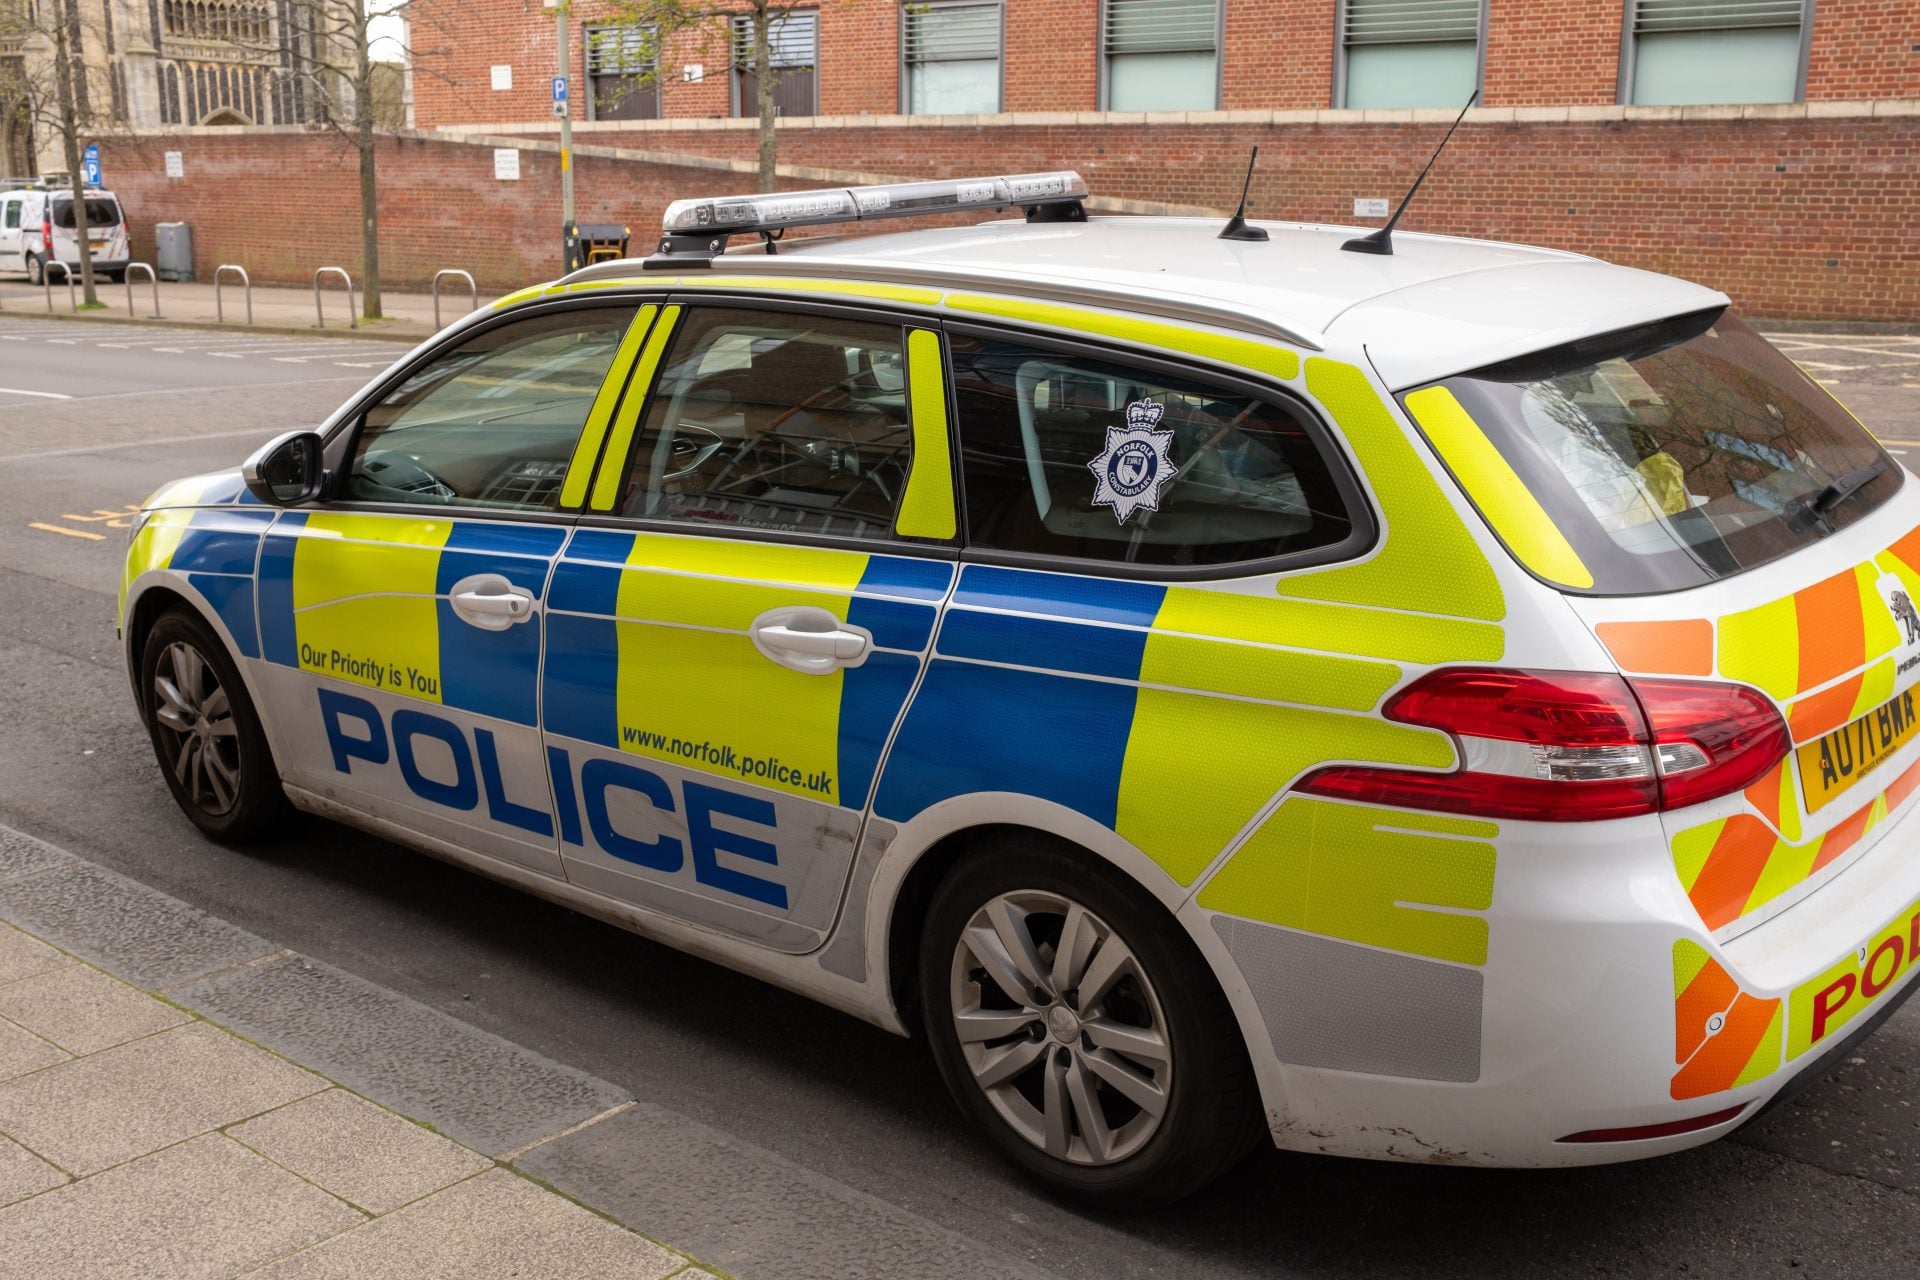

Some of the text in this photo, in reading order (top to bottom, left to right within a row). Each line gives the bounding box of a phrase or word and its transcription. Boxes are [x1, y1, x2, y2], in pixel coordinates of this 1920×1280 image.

[554, 79, 565, 99] P
[1116, 442, 1155, 460] NORFOLK
[1108, 471, 1153, 497] CONSTABULARY
[300, 642, 438, 696] Our Priority is You
[622, 724, 834, 796] www.norfolk.police.uk
[1820, 714, 1875, 791] AU71
[316, 687, 790, 911] POLICE
